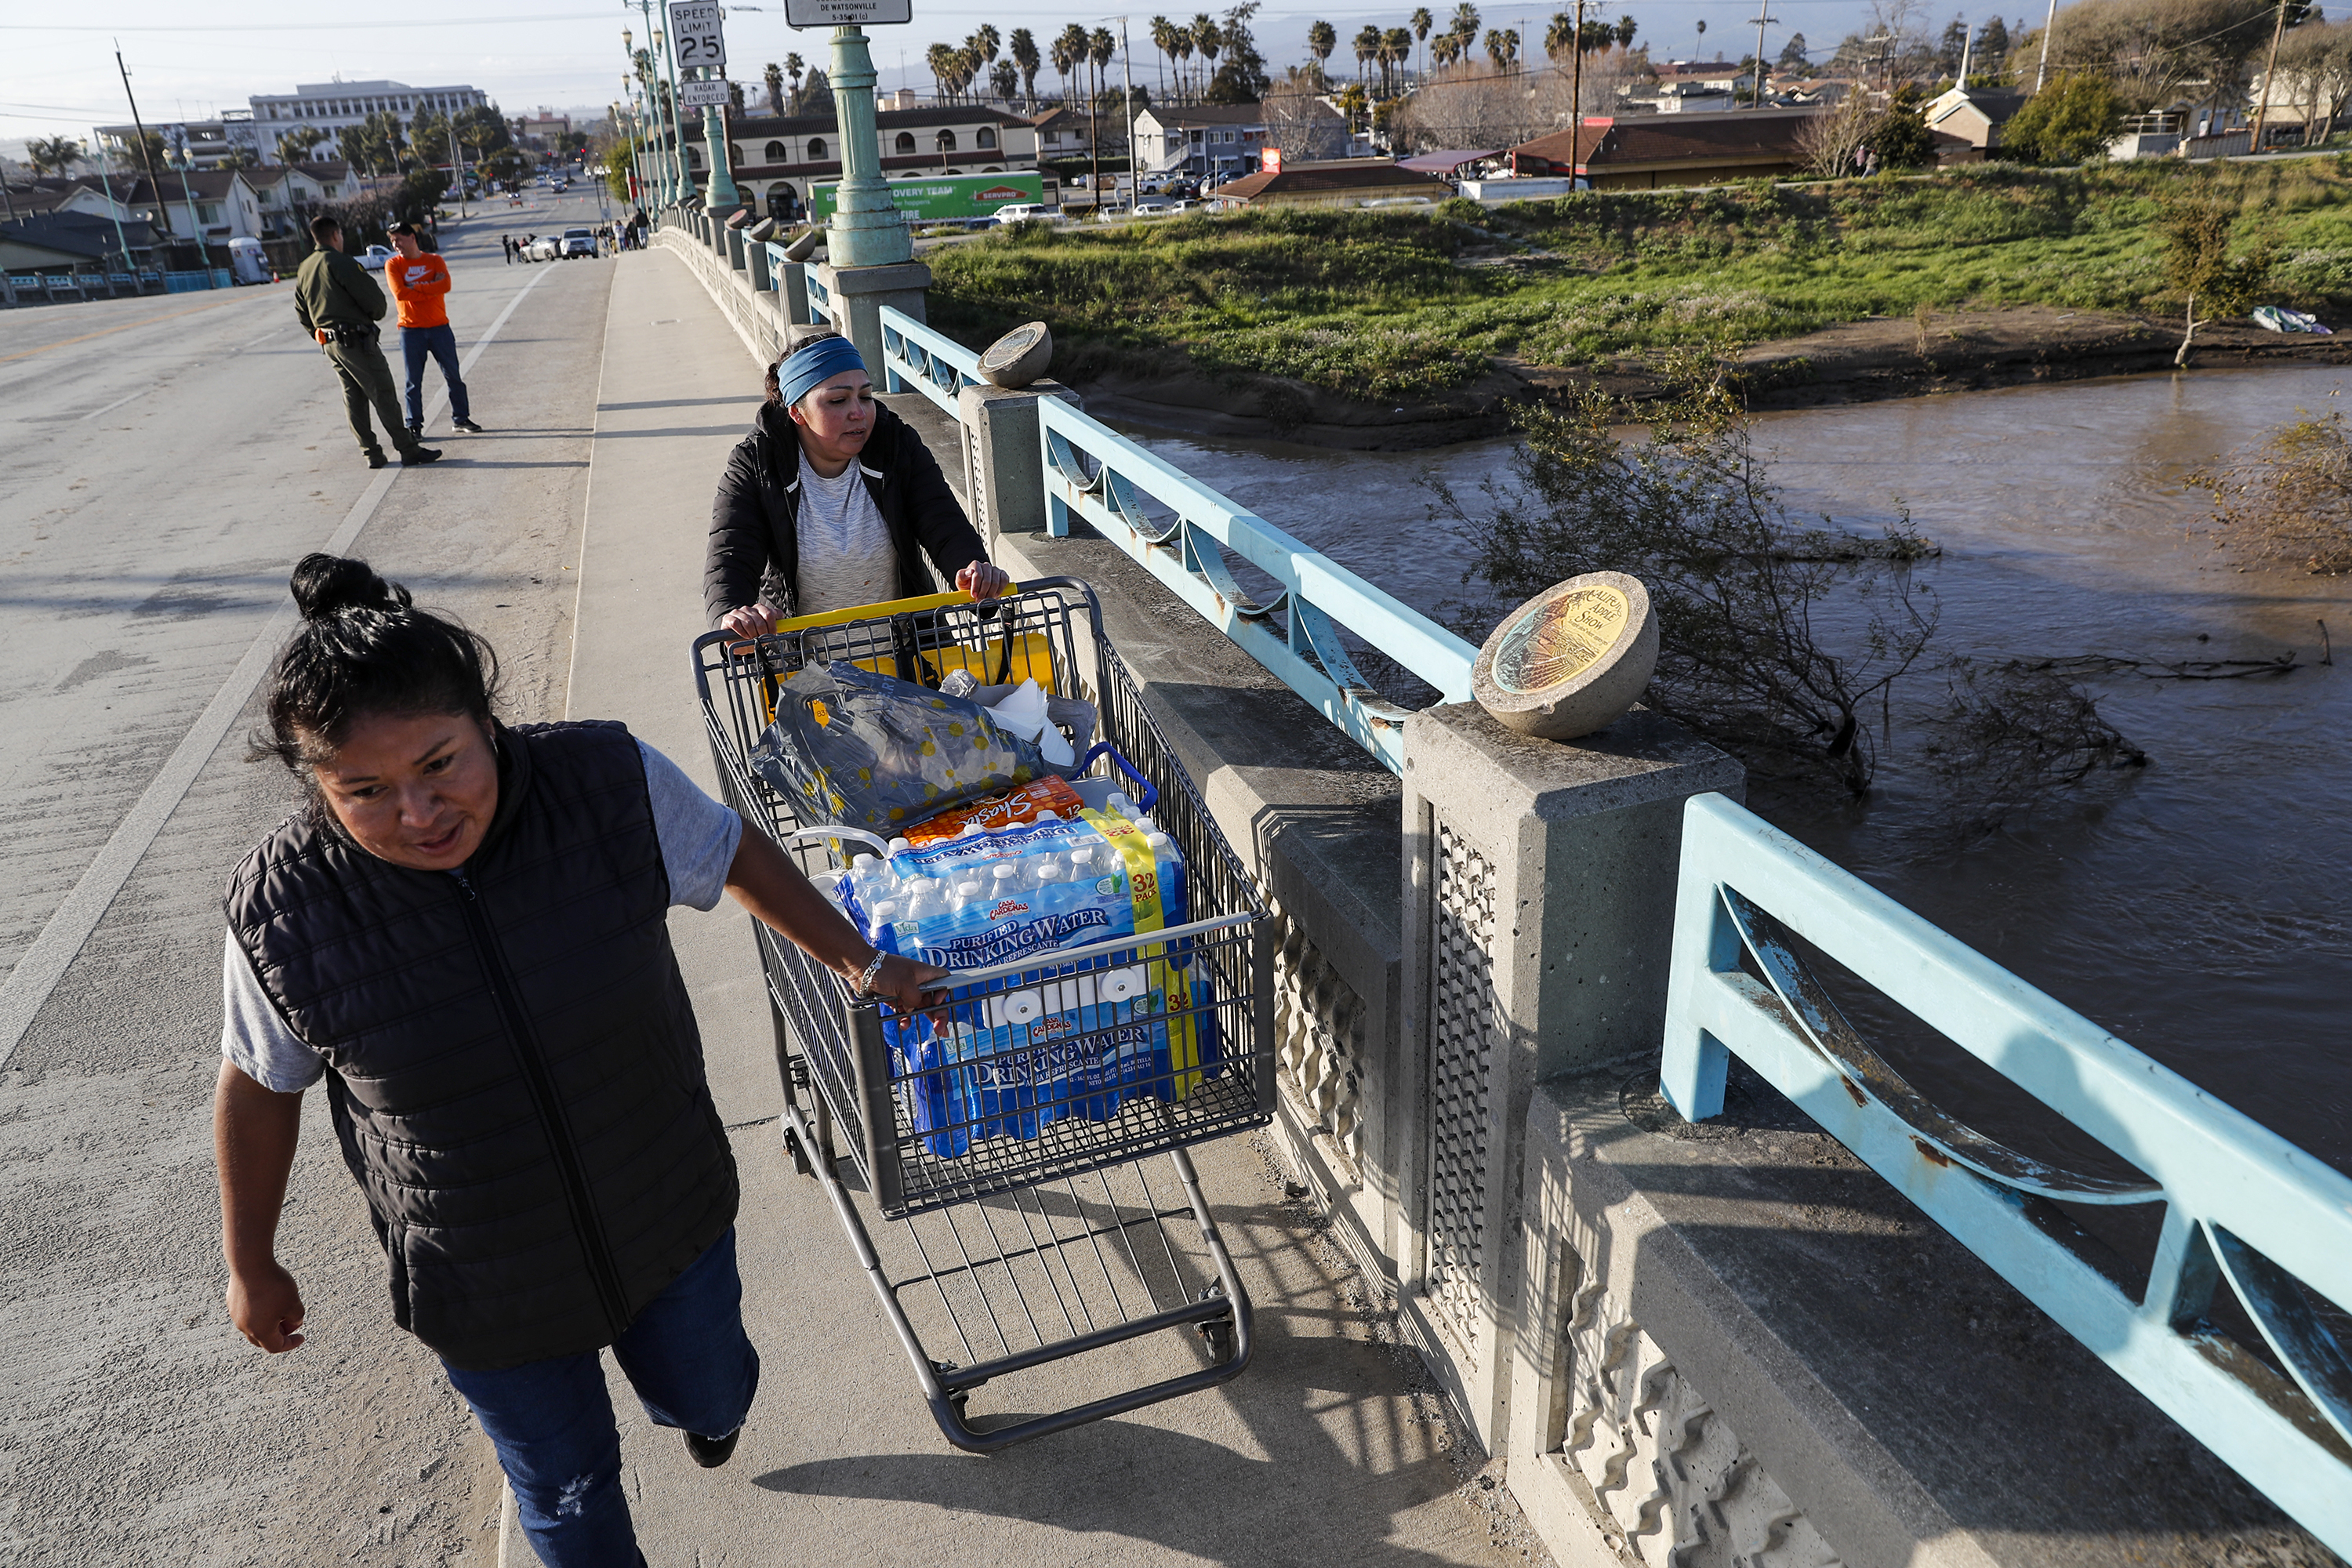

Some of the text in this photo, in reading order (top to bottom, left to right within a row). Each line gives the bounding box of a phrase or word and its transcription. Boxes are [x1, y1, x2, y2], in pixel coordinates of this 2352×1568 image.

[675, 7, 715, 20] SPEED
[681, 22, 711, 34] LIMIT
[680, 35, 720, 60] 25
[694, 84, 717, 93] RADAR
[688, 94, 725, 103] ENFORCED
[893, 186, 953, 198] OVERY TEAM
[901, 209, 920, 220] FIRE
[408, 265, 426, 275] NIKE
[1588, 602, 1617, 622] APPLE
[1574, 610, 1604, 630] SHOW
[956, 793, 1032, 826] Shasta
[1066, 804, 1080, 815] 12
[1133, 873, 1155, 892] 32
[1135, 887, 1156, 902] PACK
[990, 903, 1029, 920] CARDENAS
[998, 900, 1016, 909] CASA
[895, 921, 917, 933] Vida
[924, 910, 1105, 967] DRINKING WATER
[952, 922, 1017, 949] PURIFIED
[1004, 940, 1058, 964] REFRESCANTE
[946, 1040, 966, 1051] Via
[1075, 1028, 1143, 1054] WATER
[1045, 1057, 1099, 1078] REFRSCANTE
